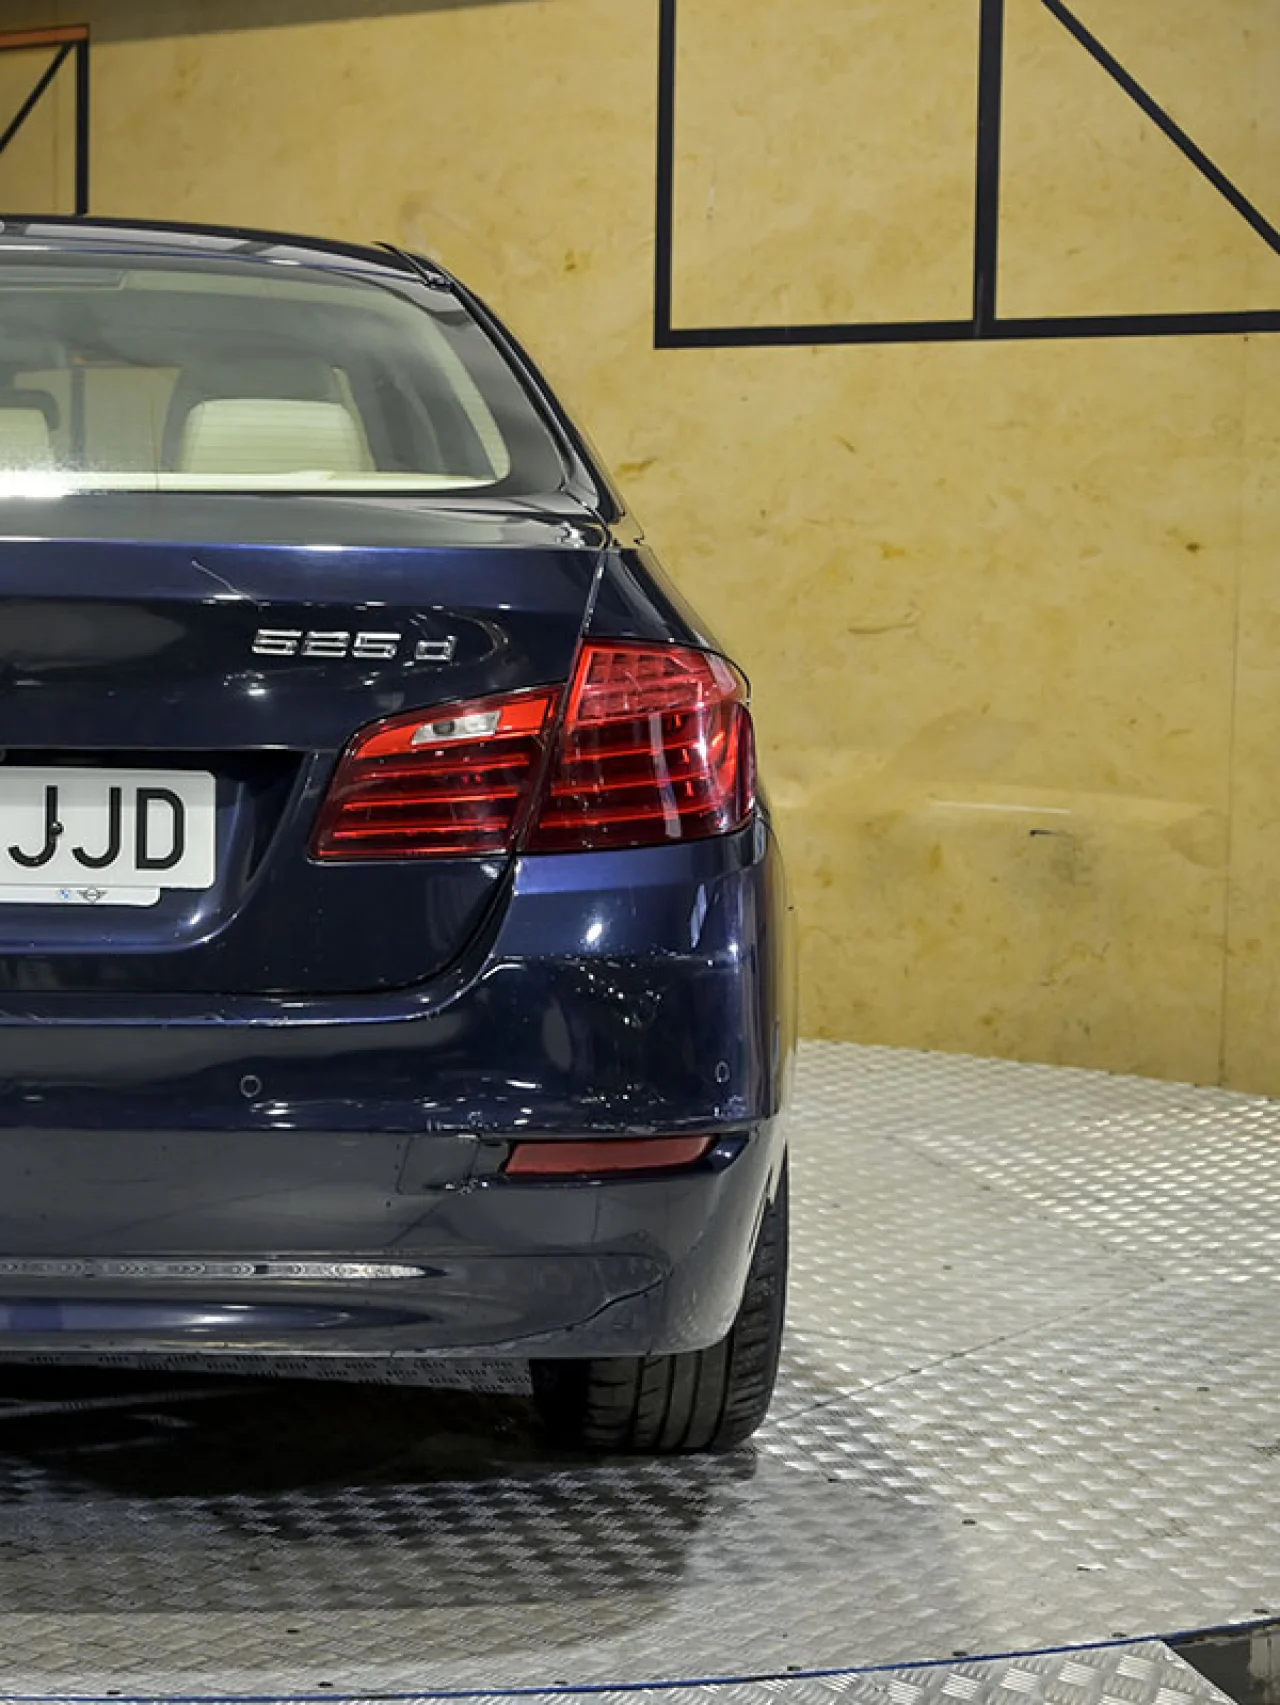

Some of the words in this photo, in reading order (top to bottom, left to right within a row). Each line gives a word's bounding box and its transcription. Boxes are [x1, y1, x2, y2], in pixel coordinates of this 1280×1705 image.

[251, 628, 402, 659] 525
[415, 635, 457, 661] d
[7, 784, 186, 871] JJD
